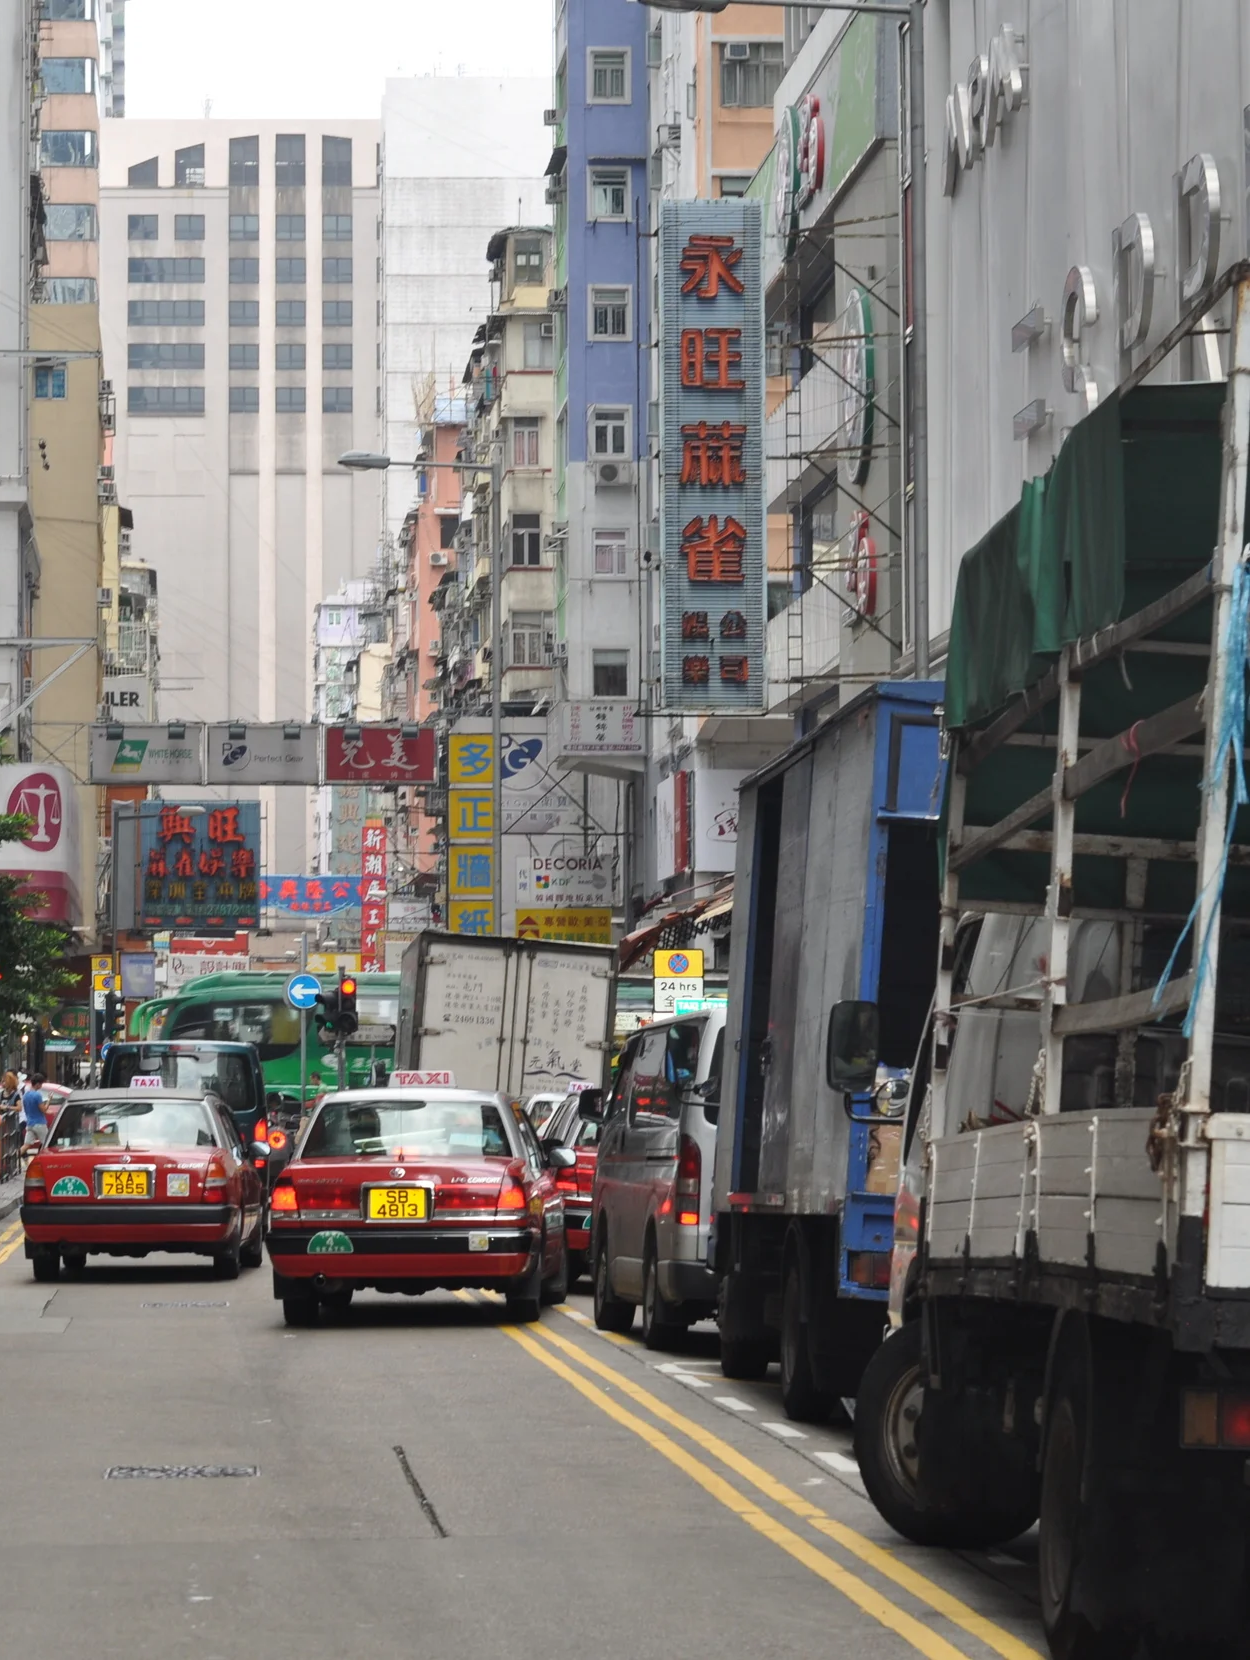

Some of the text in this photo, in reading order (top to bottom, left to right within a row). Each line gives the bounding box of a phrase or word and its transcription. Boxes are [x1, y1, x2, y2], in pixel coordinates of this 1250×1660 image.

[533, 858, 604, 871] DECORIA
[660, 981, 698, 991] 24 hrs
[677, 1001, 727, 1011] TAXI STAN
[133, 1078, 161, 1088] TAXI
[395, 1072, 450, 1085] TAXI
[114, 1171, 134, 1184] KA
[467, 1176, 500, 1184] COMFORT
[105, 1183, 145, 1195] 7855
[385, 1190, 409, 1203] SB
[376, 1203, 418, 1217] 4813
